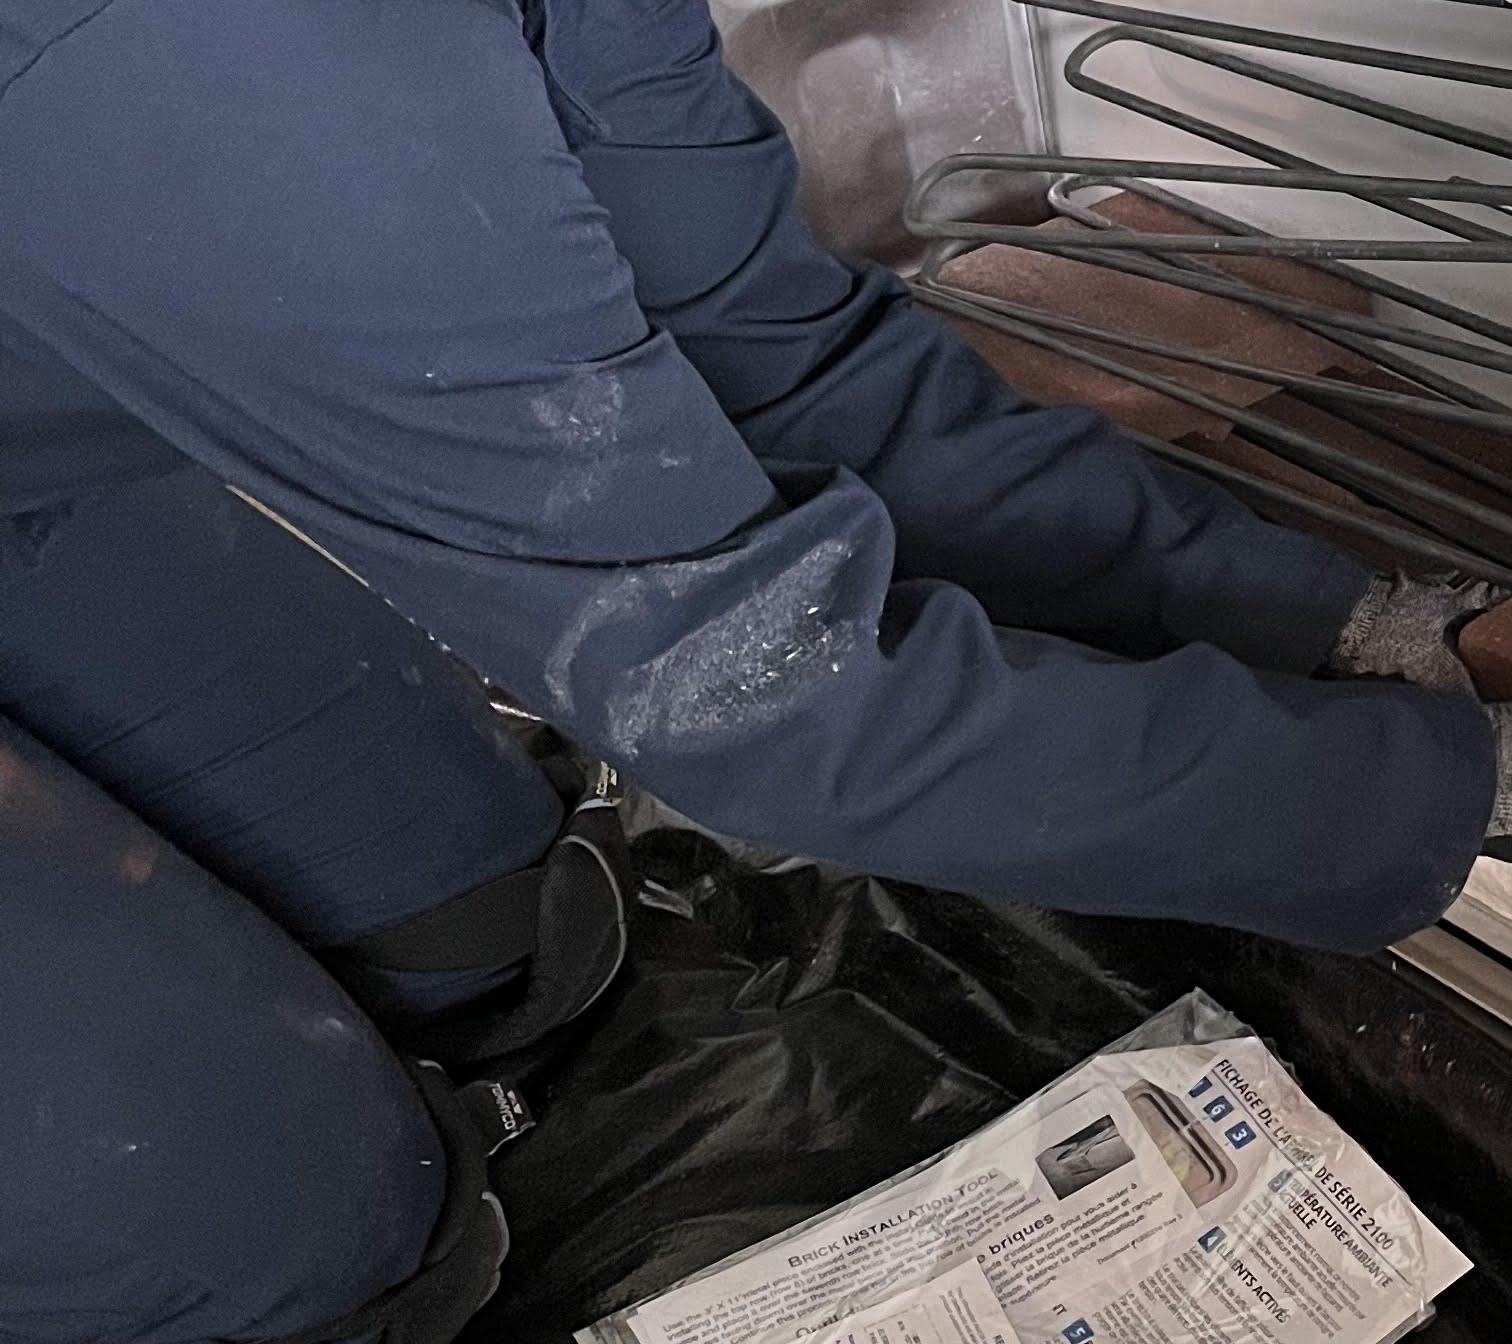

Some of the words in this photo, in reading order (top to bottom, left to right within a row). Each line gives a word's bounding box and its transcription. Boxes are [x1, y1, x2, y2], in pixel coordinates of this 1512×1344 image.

[1209, 1101, 1224, 1116] 6
[1231, 1126, 1248, 1143] 3
[1215, 1058, 1262, 1109] FICHAGE
[1315, 1166, 1333, 1185] DE
[1328, 1177, 1369, 1220] SÉRIE
[1361, 1216, 1395, 1250] 2100
[788, 1239, 840, 1268] BRICK
[842, 1192, 954, 1245] INSTALLATION
[955, 1168, 998, 1197] TOOL
[988, 1212, 1055, 1257] briques
[1343, 1235, 1393, 1288] AMBIANTE
[1251, 1283, 1294, 1324] ACTIVÉS
